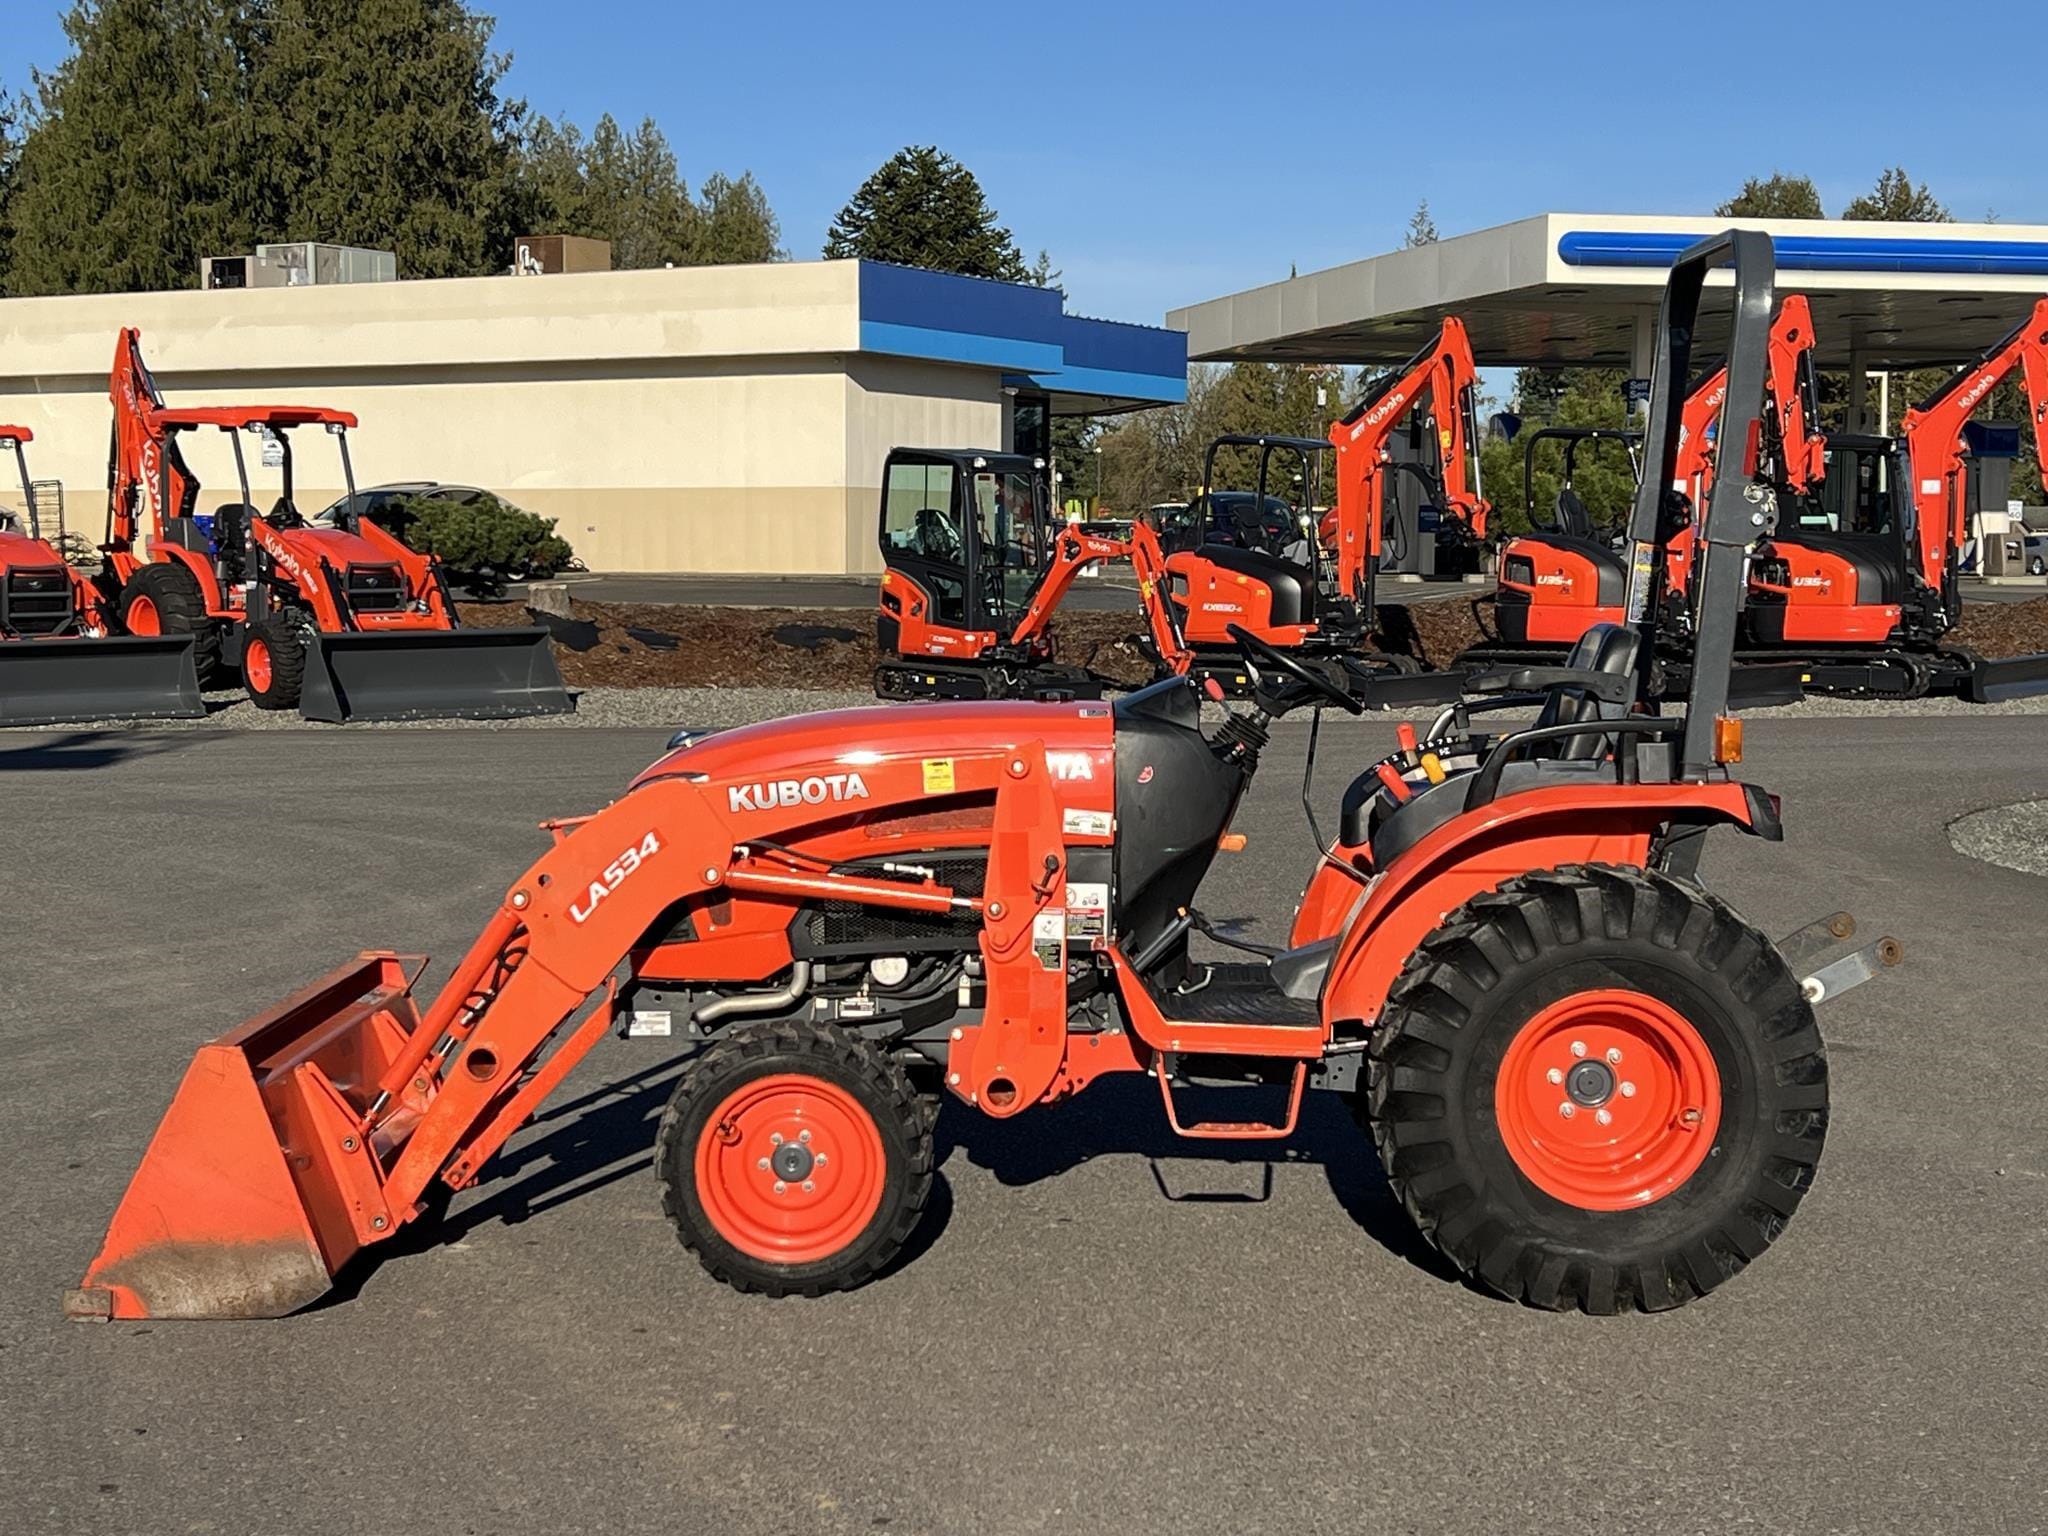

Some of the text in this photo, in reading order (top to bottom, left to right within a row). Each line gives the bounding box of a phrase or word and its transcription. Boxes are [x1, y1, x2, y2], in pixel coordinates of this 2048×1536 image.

[1366, 393, 1404, 426] Kubota
[1958, 375, 1995, 408] Kubota
[264, 533, 300, 576] Kubota
[727, 772, 870, 813] KUBOTA
[569, 831, 660, 923] LA534
